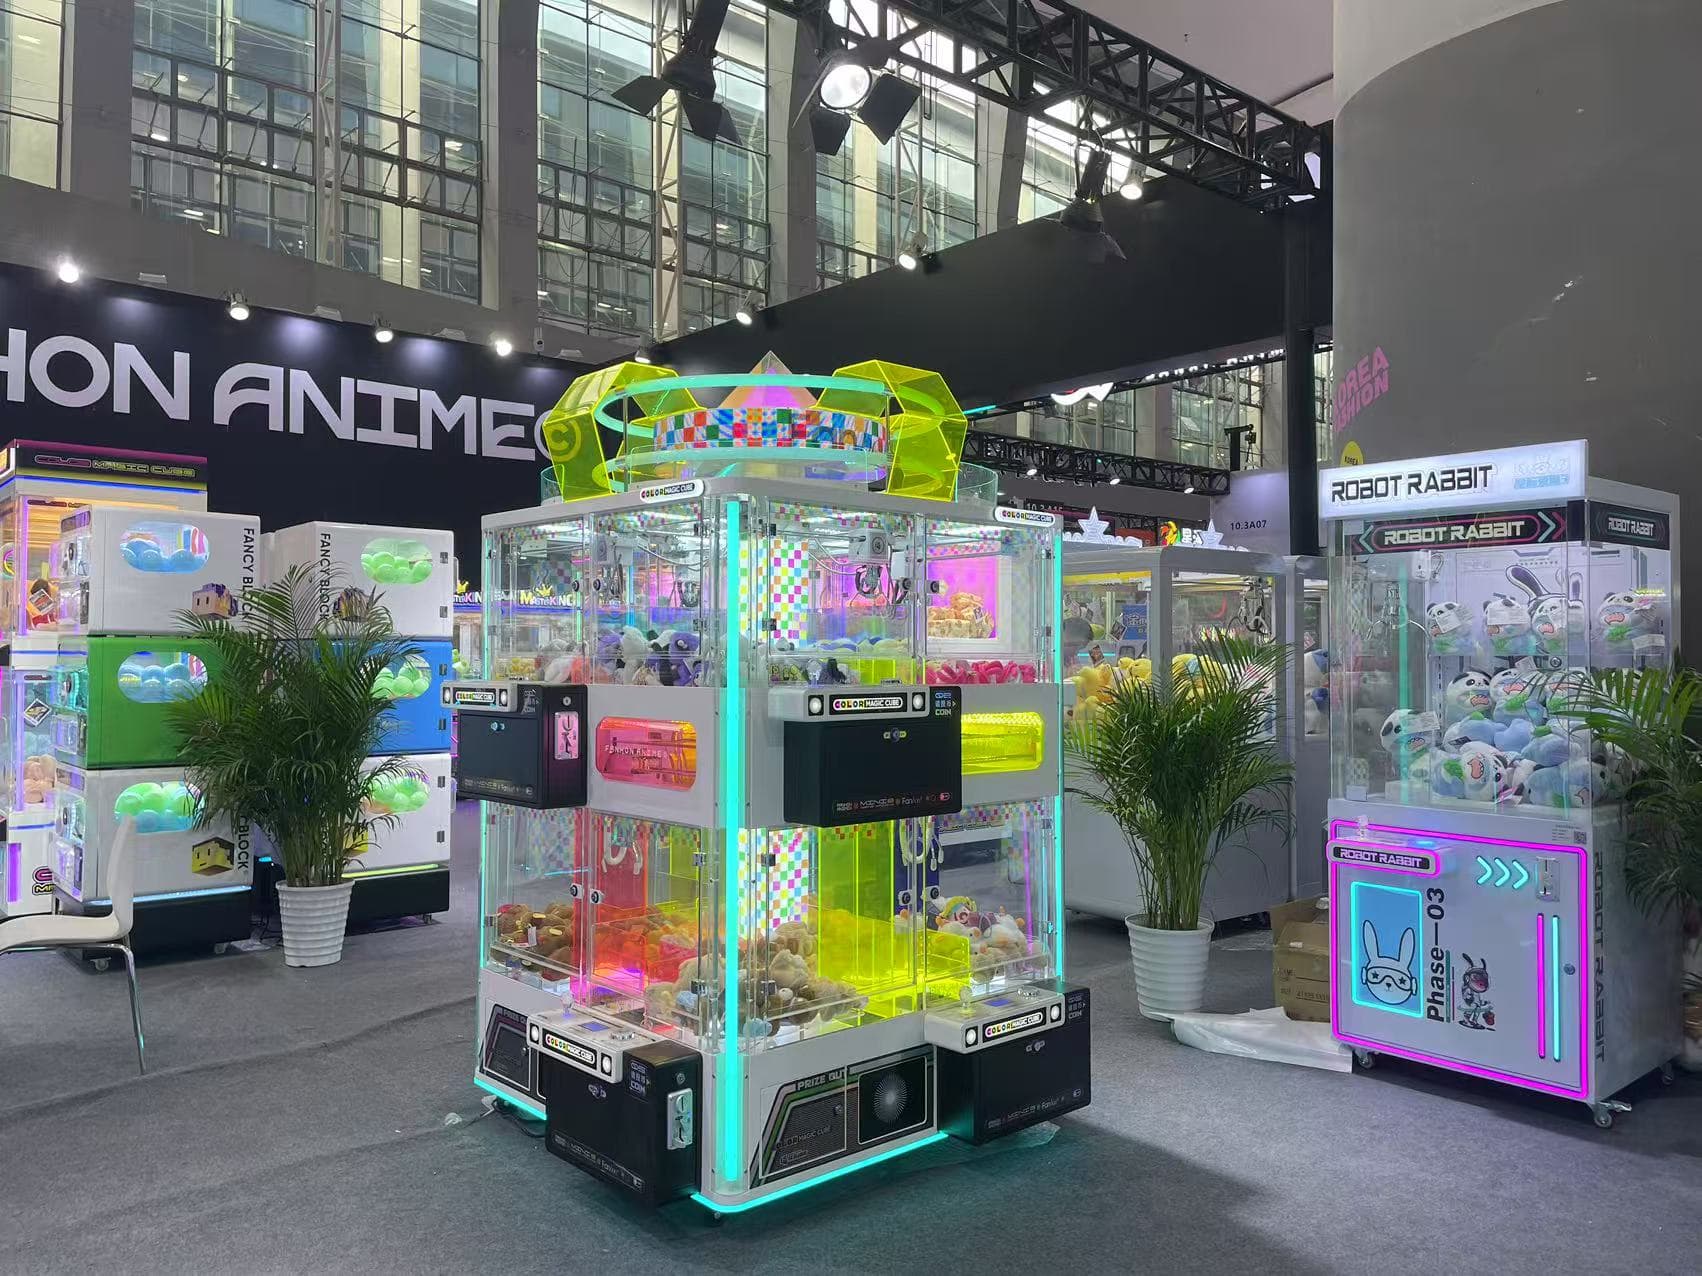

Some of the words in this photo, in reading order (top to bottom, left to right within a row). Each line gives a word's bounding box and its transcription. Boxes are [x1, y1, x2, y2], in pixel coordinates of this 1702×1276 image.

[1334, 345, 1389, 410] OREA
[641, 488, 664, 498] COLOR
[664, 486, 680, 495] MAGIC
[680, 483, 694, 492] CUBE
[1332, 475, 1402, 502] ROBOT
[1407, 465, 1493, 495] RABBIT
[1002, 510, 1025, 519] COLOR
[1230, 520, 1267, 530] 10.3A07
[1384, 528, 1449, 545] ROBOT
[1450, 521, 1525, 540] RABBIT
[1608, 517, 1630, 532] ROBOT
[1631, 520, 1655, 537] RABBIT
[243, 528, 254, 572] FANCY
[319, 533, 331, 576] FANCY
[835, 700, 865, 709] COLOR
[865, 700, 884, 708] MAGIC
[884, 699, 900, 707] CUBE
[935, 708, 952, 716] COIN
[237, 825, 249, 869] BLOCK
[1339, 848, 1379, 863] ROBOT
[1379, 853, 1423, 868] RABBIT
[1594, 851, 1604, 948] ROBOT
[1594, 956, 1605, 1062] RABBIT
[987, 1023, 1011, 1036] COLOR
[547, 1035, 568, 1051] COLOR
[798, 1075, 826, 1091] PRIZE
